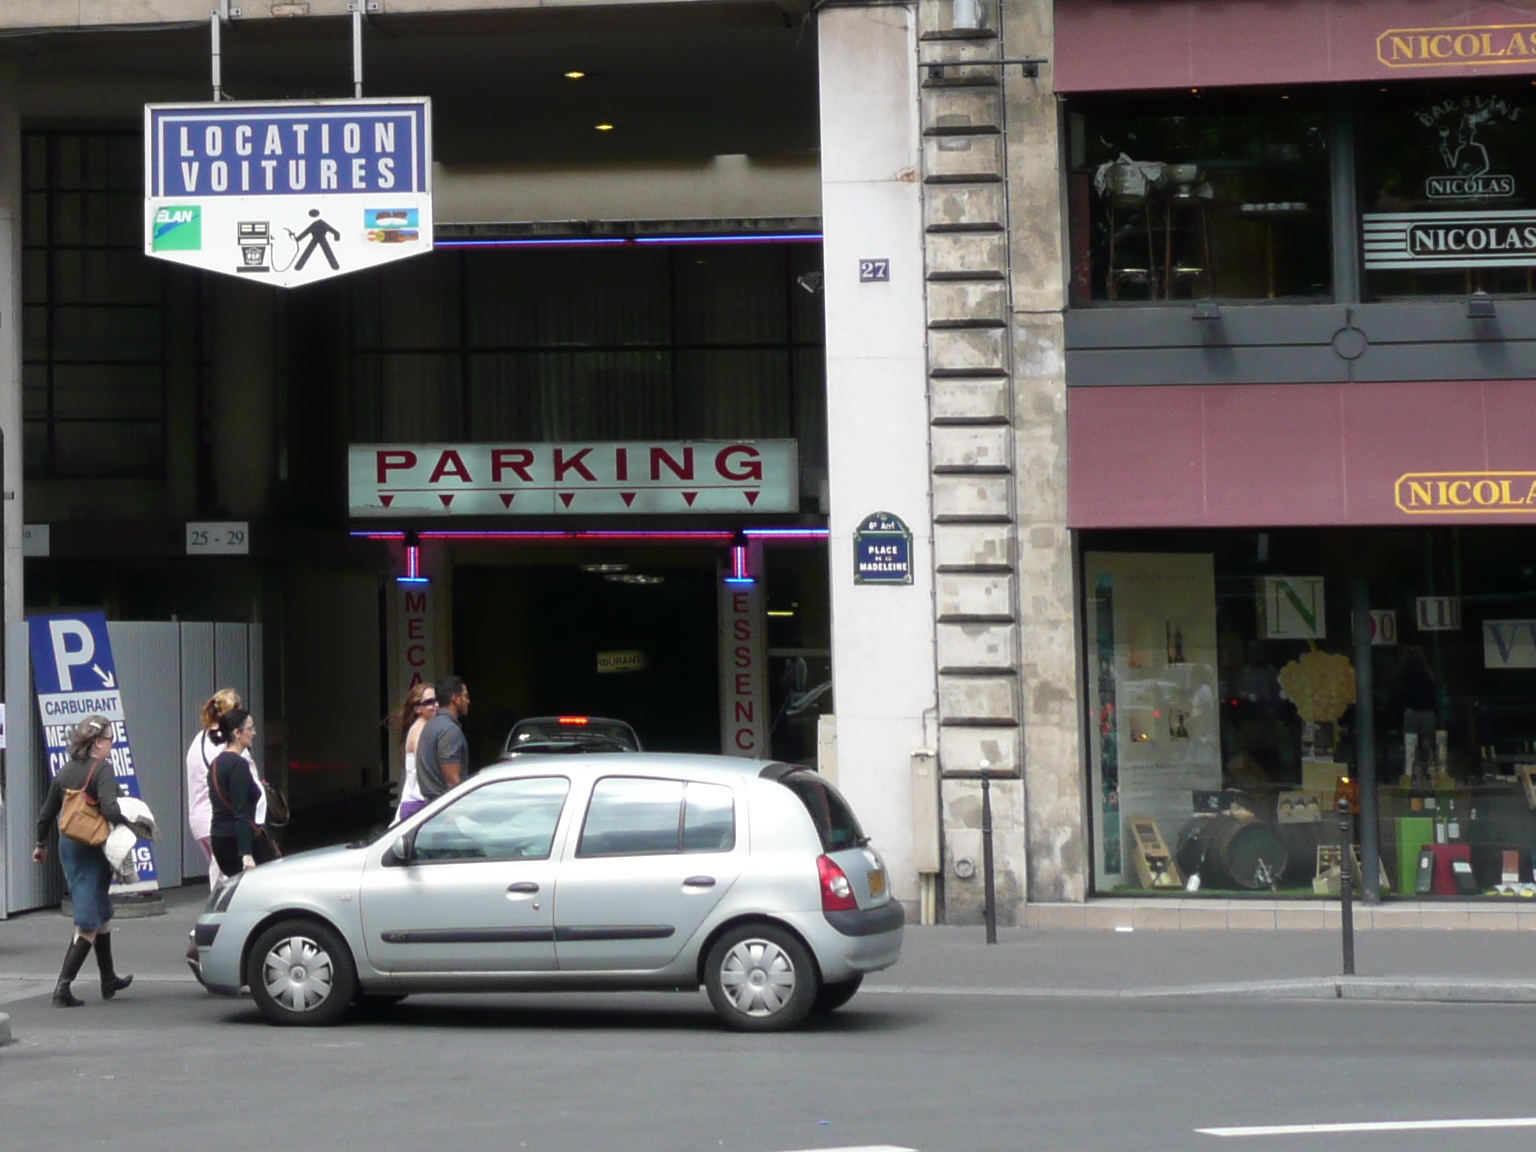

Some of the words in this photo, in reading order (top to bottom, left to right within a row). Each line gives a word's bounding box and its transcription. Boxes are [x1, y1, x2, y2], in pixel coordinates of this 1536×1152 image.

[180, 122, 395, 157] LOCATION
[181, 158, 395, 192] VOITURES
[1430, 178, 1510, 195] NICOLAS
[861, 262, 886, 278] 27
[375, 444, 763, 485] PARKING
[191, 531, 209, 546] 25
[227, 531, 244, 546] 29
[868, 545, 898, 555] PLACE
[859, 562, 907, 571] MADELEINE
[49, 619, 95, 692] P
[45, 698, 119, 716] CARBURANT
